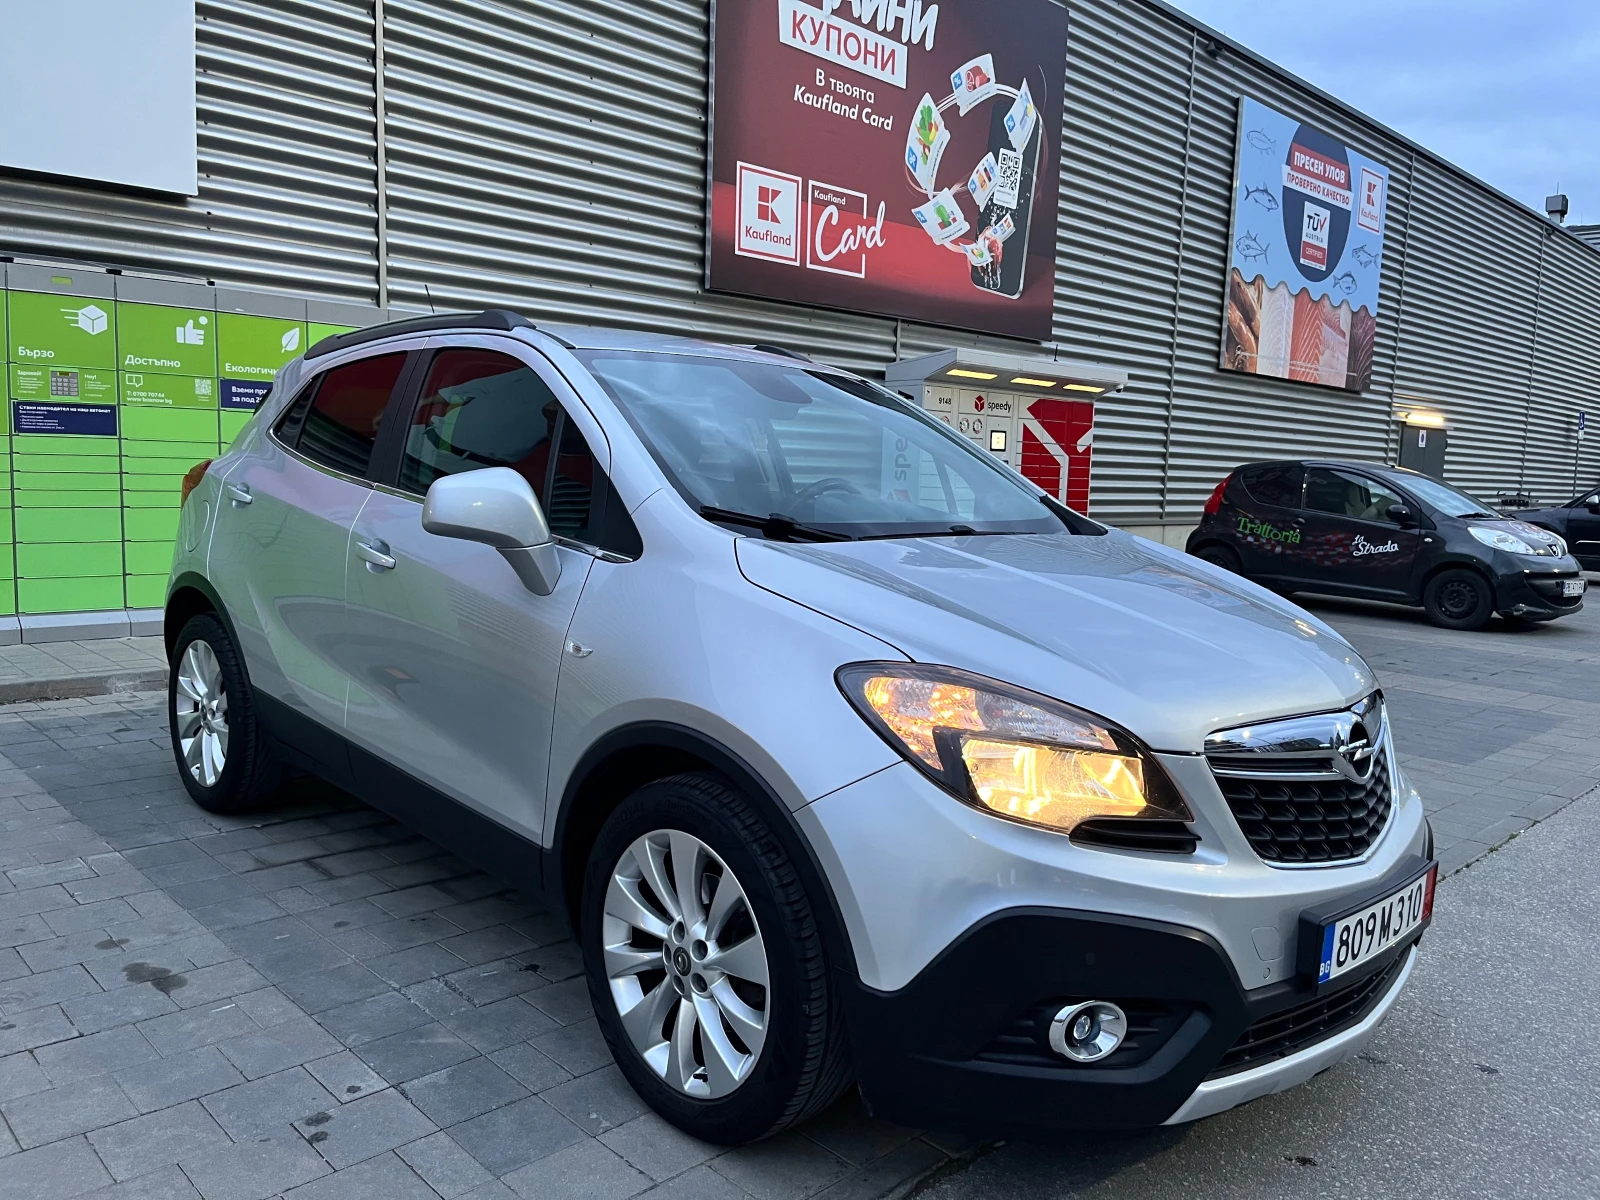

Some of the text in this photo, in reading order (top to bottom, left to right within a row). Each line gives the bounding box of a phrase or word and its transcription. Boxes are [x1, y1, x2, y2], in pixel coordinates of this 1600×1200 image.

[792, 9, 896, 76] КУПОНИ
[816, 68, 875, 104] В твоята
[794, 84, 893, 131] Kaufland Card
[1294, 151, 1346, 184] ПРЕСЕН УЛОВ
[814, 189, 846, 205] Kaufland
[1286, 172, 1350, 206] ПРОВЕРЕНО КАЧЕСТВО
[1361, 207, 1379, 222] Kaufland
[745, 225, 792, 246] Kaufland
[815, 200, 886, 262] Card
[1305, 231, 1324, 244] AUSTRIA
[1305, 247, 1323, 259] CERTIFIED
[18, 346, 55, 359] Бързо
[125, 355, 181, 368] Достъпно
[231, 385, 254, 393] Вземи
[987, 401, 1012, 414] speedy
[1236, 516, 1301, 544] Trattoria
[1352, 540, 1399, 557] Strada
[1319, 960, 1331, 977] BG
